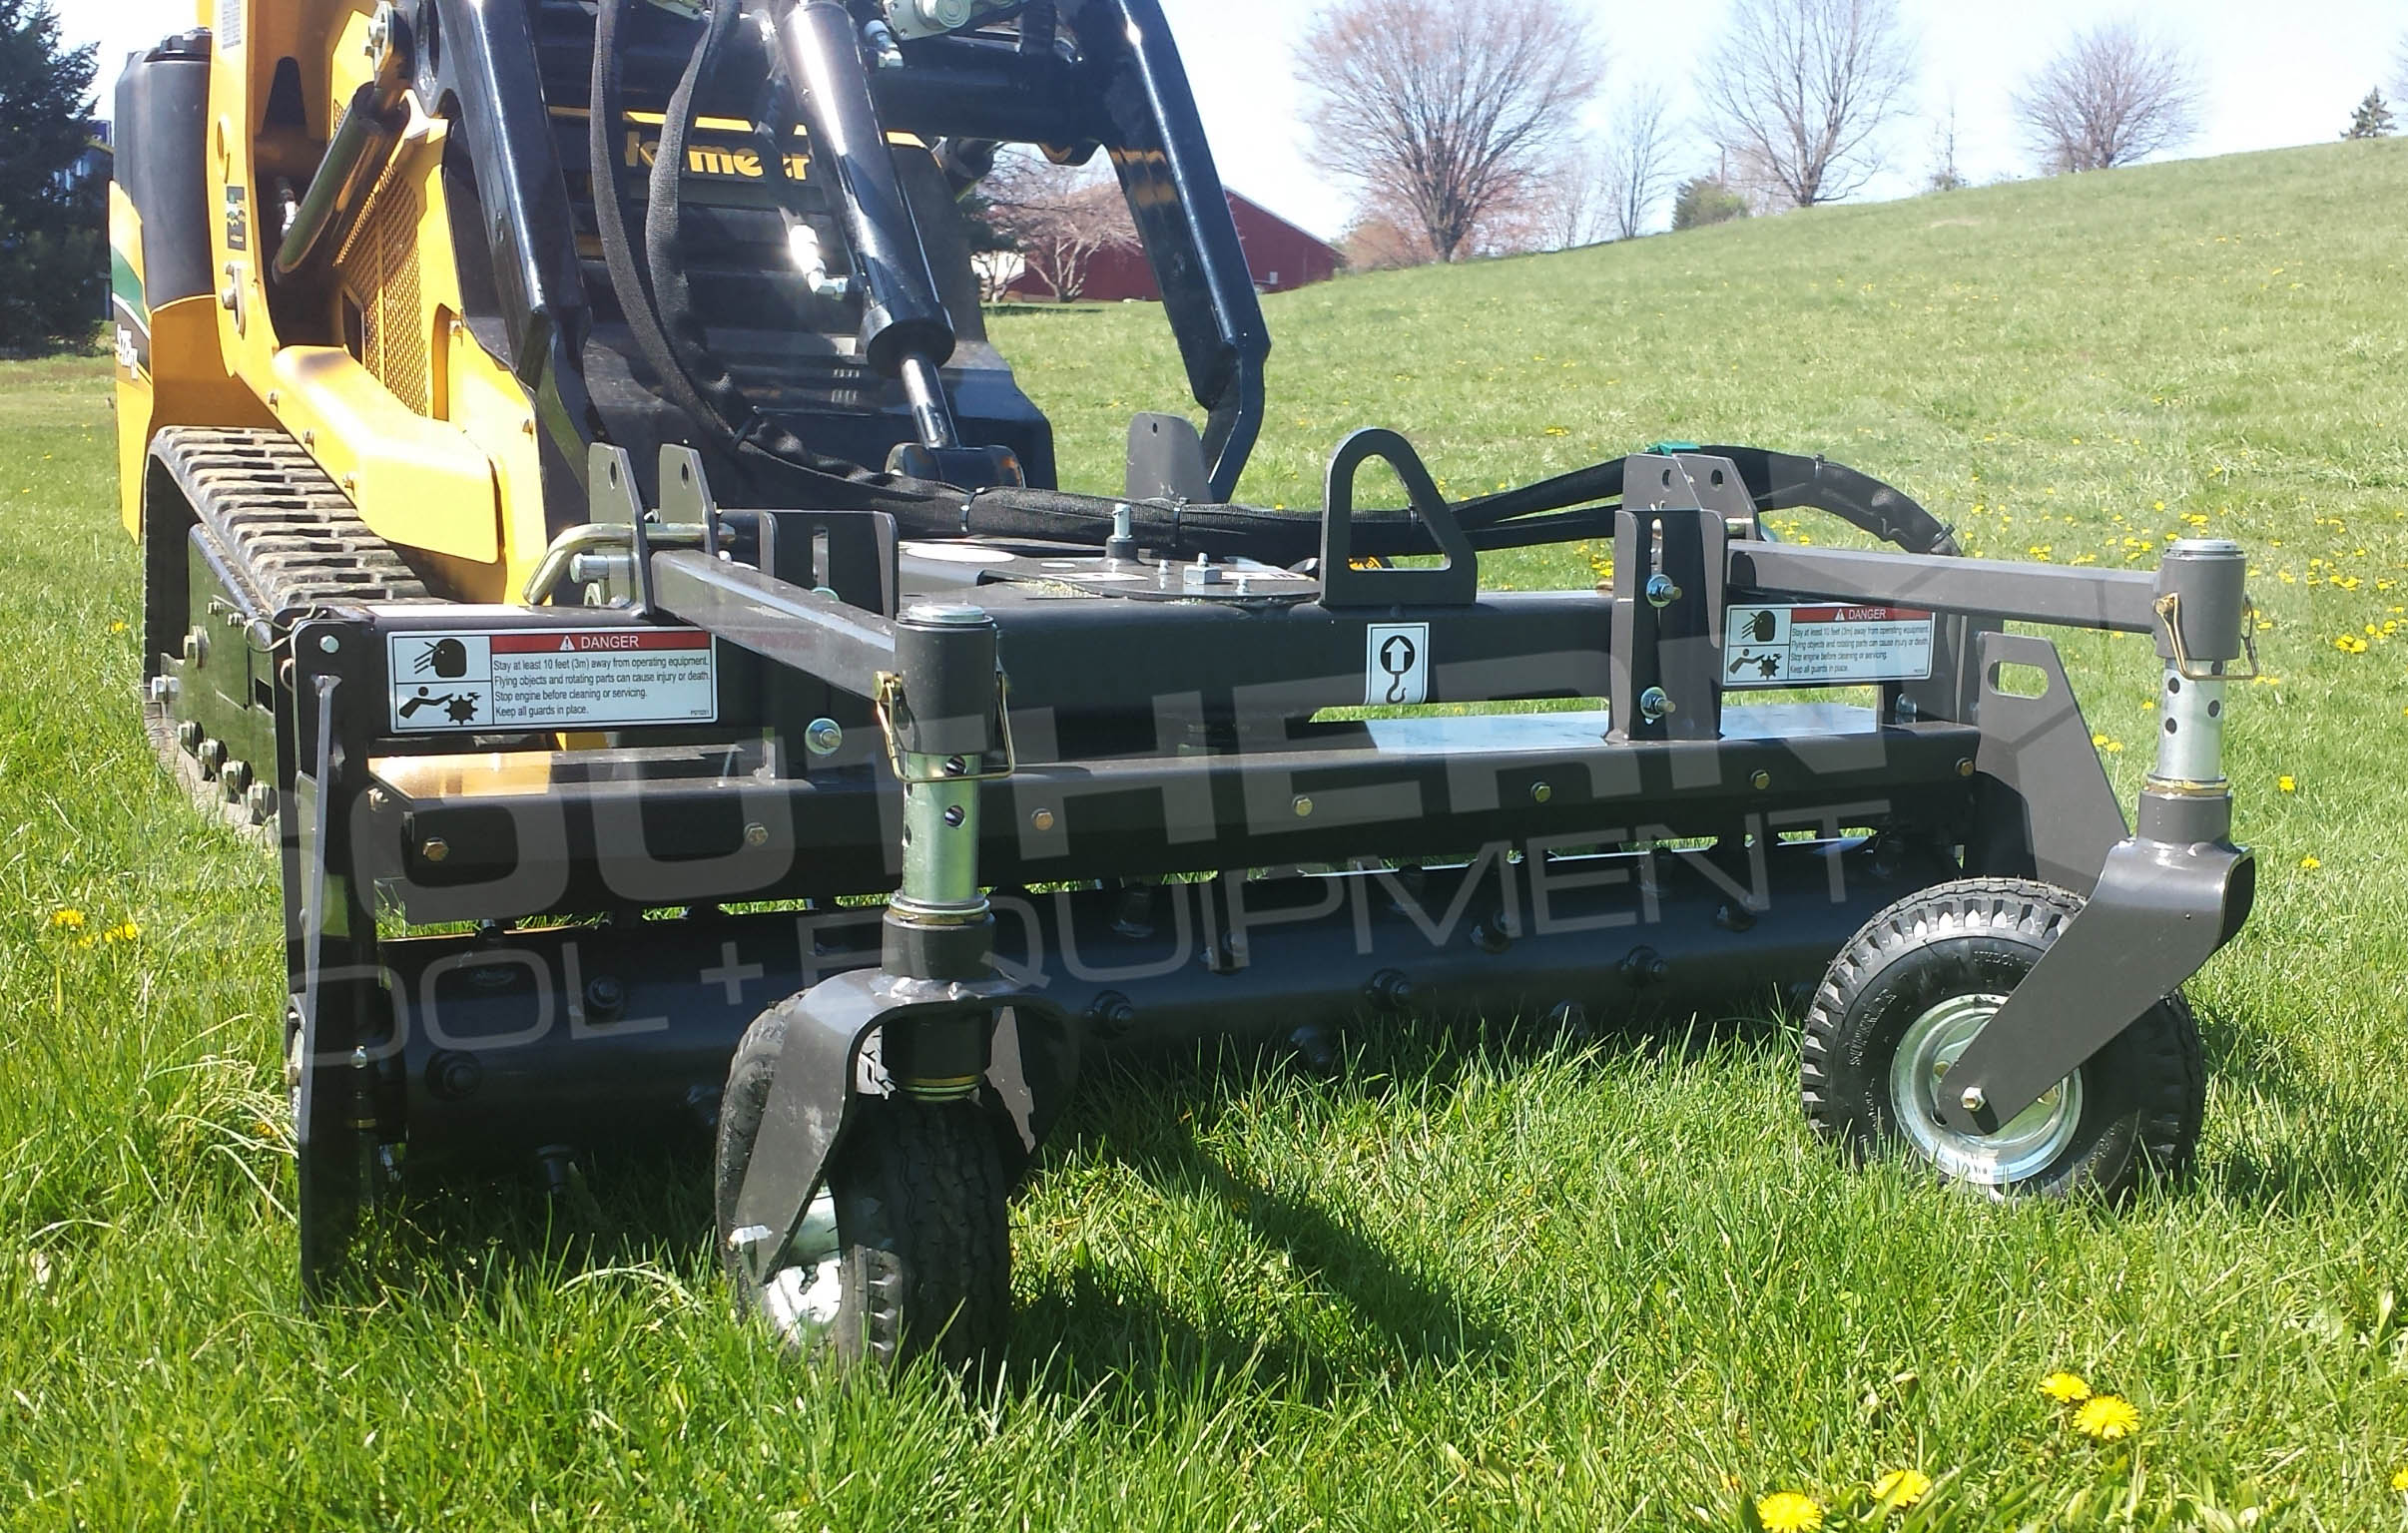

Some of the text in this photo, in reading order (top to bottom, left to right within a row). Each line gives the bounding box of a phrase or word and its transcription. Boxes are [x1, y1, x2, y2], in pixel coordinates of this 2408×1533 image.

[1848, 608, 1887, 621] DANGER
[581, 635, 639, 649] DANGER
[494, 660, 511, 673] Stay
[513, 661, 520, 671] at
[523, 660, 541, 670] least
[544, 659, 553, 670] 10
[555, 658, 569, 670] feet
[571, 658, 589, 671] (3m)
[591, 659, 611, 670] away
[613, 658, 629, 668] from
[631, 657, 666, 670] operating
[494, 676, 517, 689] Flying
[519, 675, 547, 688] objects
[549, 674, 564, 685] and
[566, 673, 594, 686] rotating
[596, 674, 615, 685] parts
[616, 674, 630, 683] can
[632, 673, 654, 683] cause
[657, 672, 676, 684] injury
[679, 672, 686, 682] or
[495, 687, 647, 703] Stop engine before cleaning or servicing.
[495, 704, 589, 718] Keep all guards in place.
